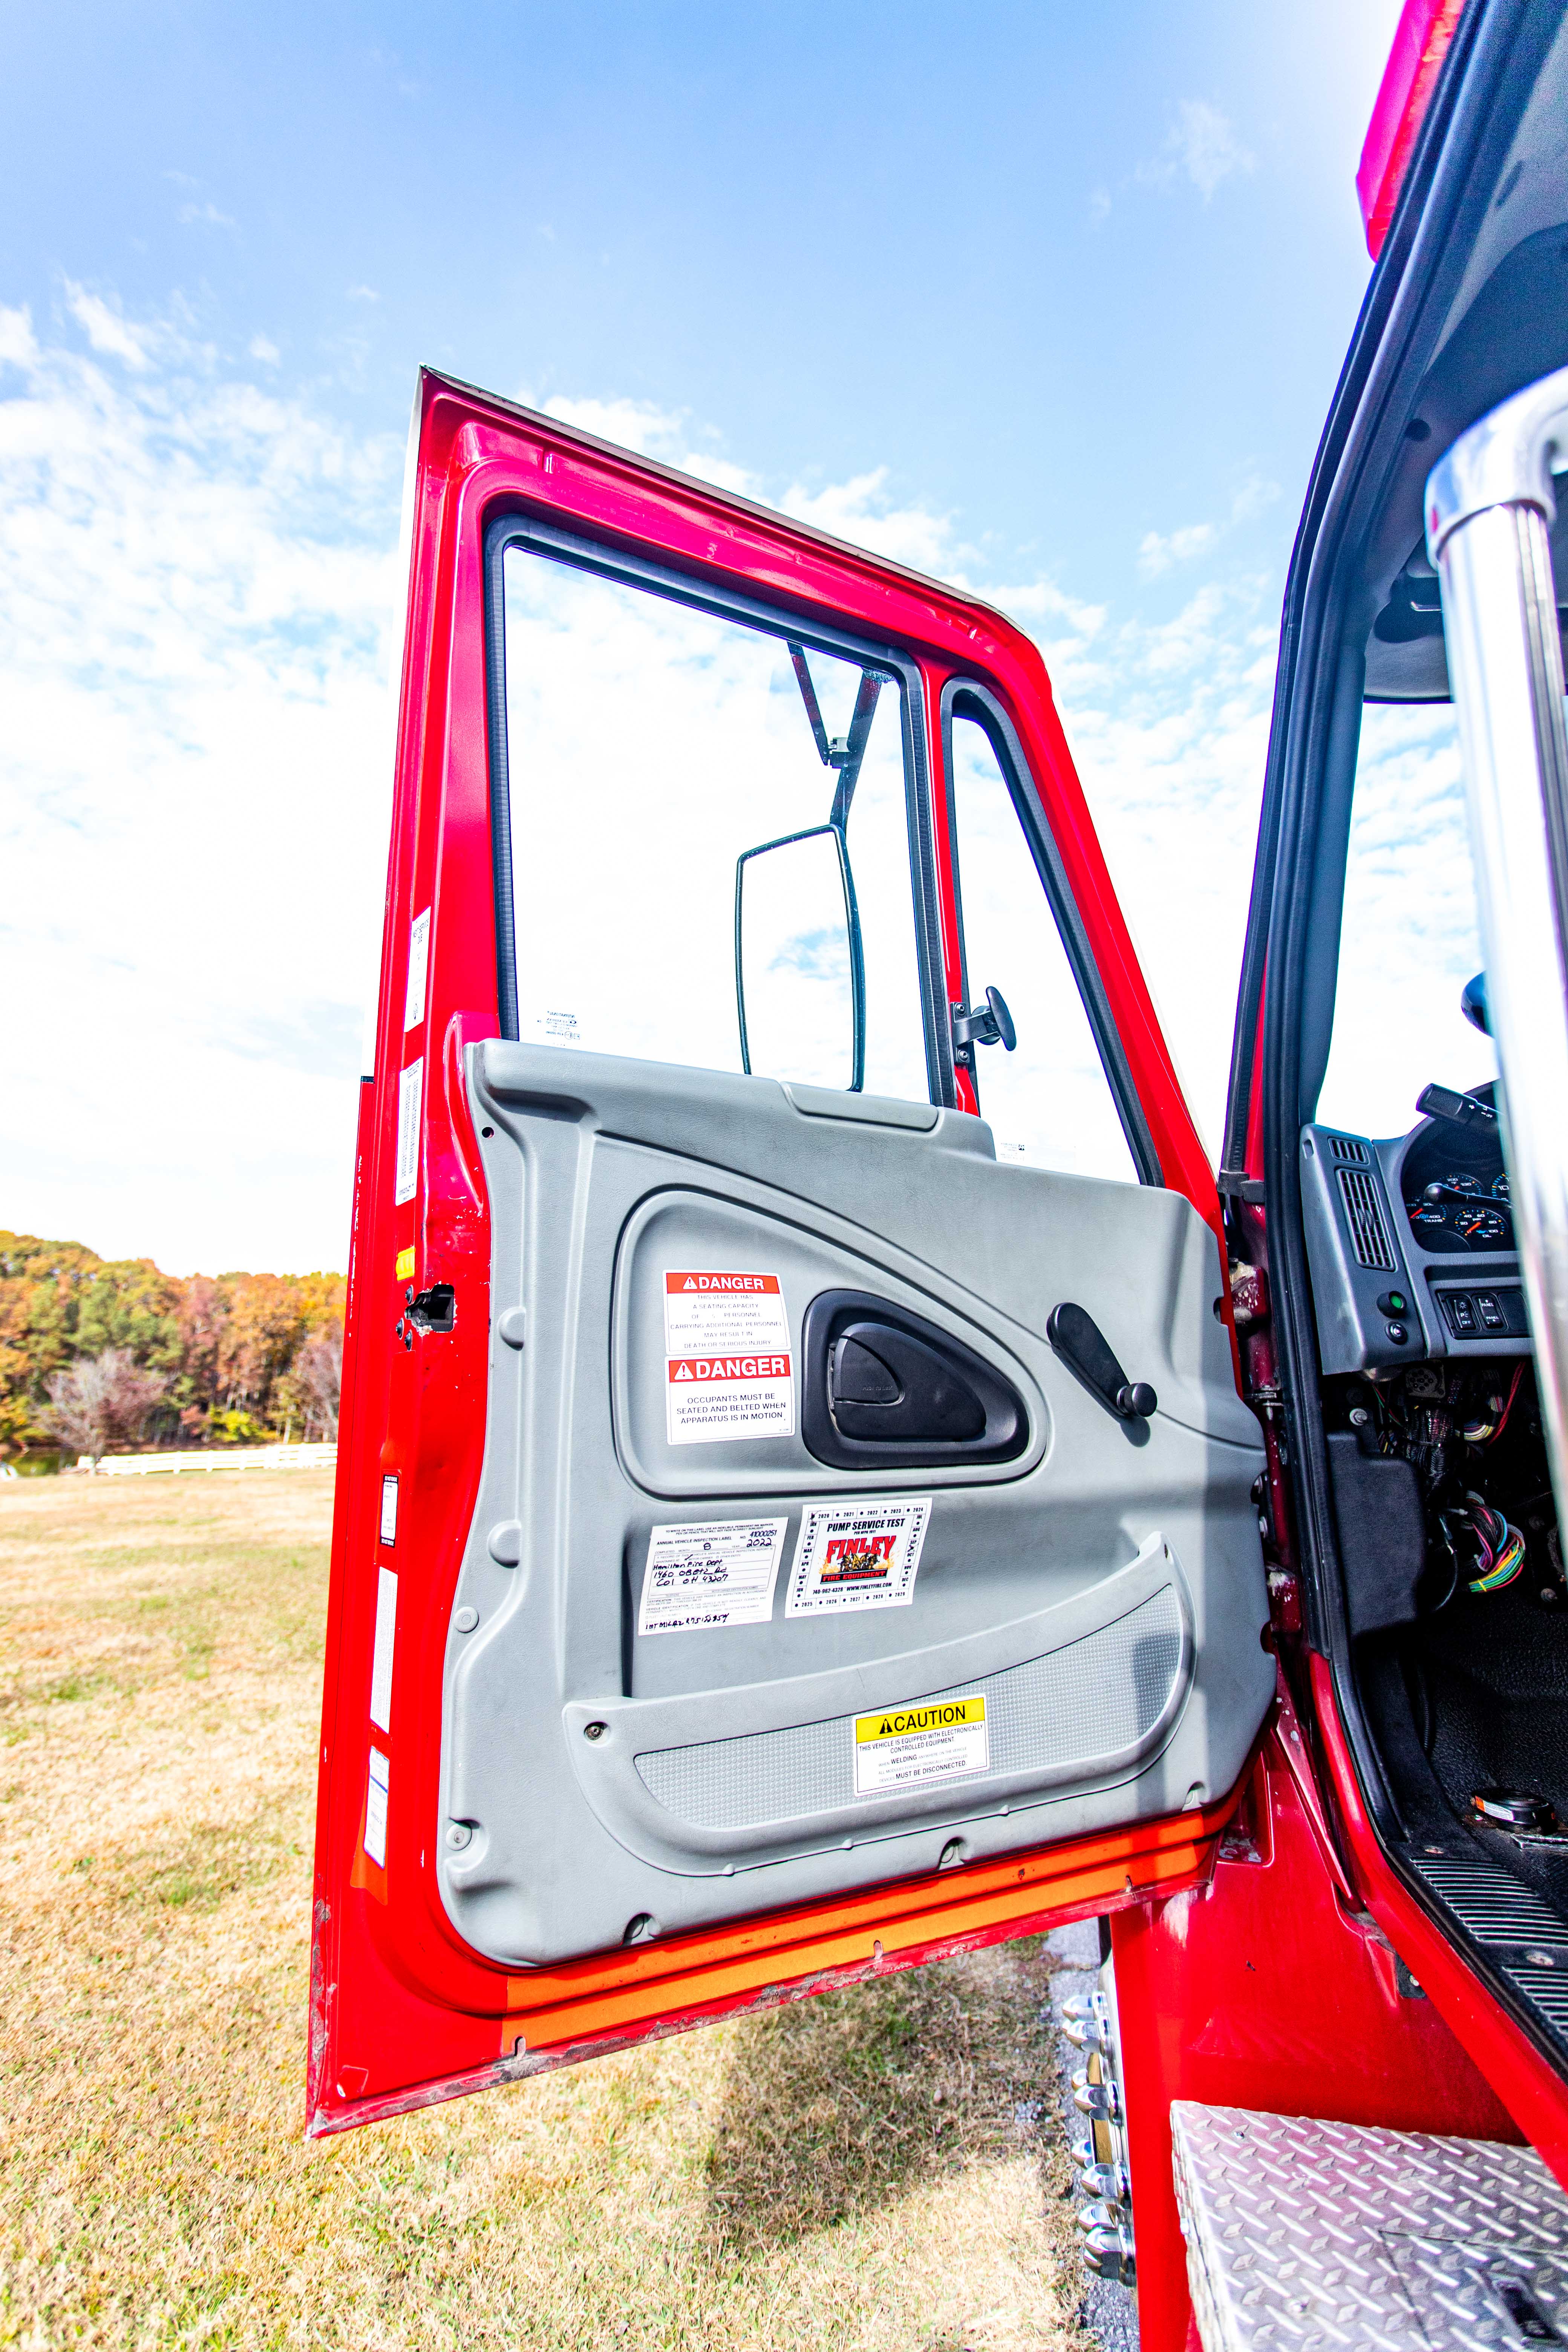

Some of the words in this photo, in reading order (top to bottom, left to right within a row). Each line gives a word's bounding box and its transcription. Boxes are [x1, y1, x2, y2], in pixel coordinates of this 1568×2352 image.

[698, 1276, 764, 1290] DANGER
[696, 1357, 785, 1378] DANGER
[688, 1395, 737, 1404] OCCUPANTS
[681, 1415, 728, 1424] APPARATUS
[827, 1522, 851, 1532] PUMP
[852, 1519, 885, 1530] SERVICE
[887, 1518, 905, 1528] TEST
[746, 1537, 772, 1548] 2022
[827, 1535, 897, 1564] FINLEY
[843, 1571, 885, 1580] EQUIPMENT
[847, 1582, 892, 1591] WWW.FINLEYFIRE.COM
[894, 1705, 966, 1732] CAUTION
[873, 1740, 894, 1749] VEHICLE
[902, 1735, 926, 1744] EQUIPPED
[942, 1724, 983, 1736] ELECTRONICALLY
[890, 1742, 924, 1753] CONTROLLED
[891, 1755, 917, 1764] WELDING
[896, 1771, 912, 1779] MUST
